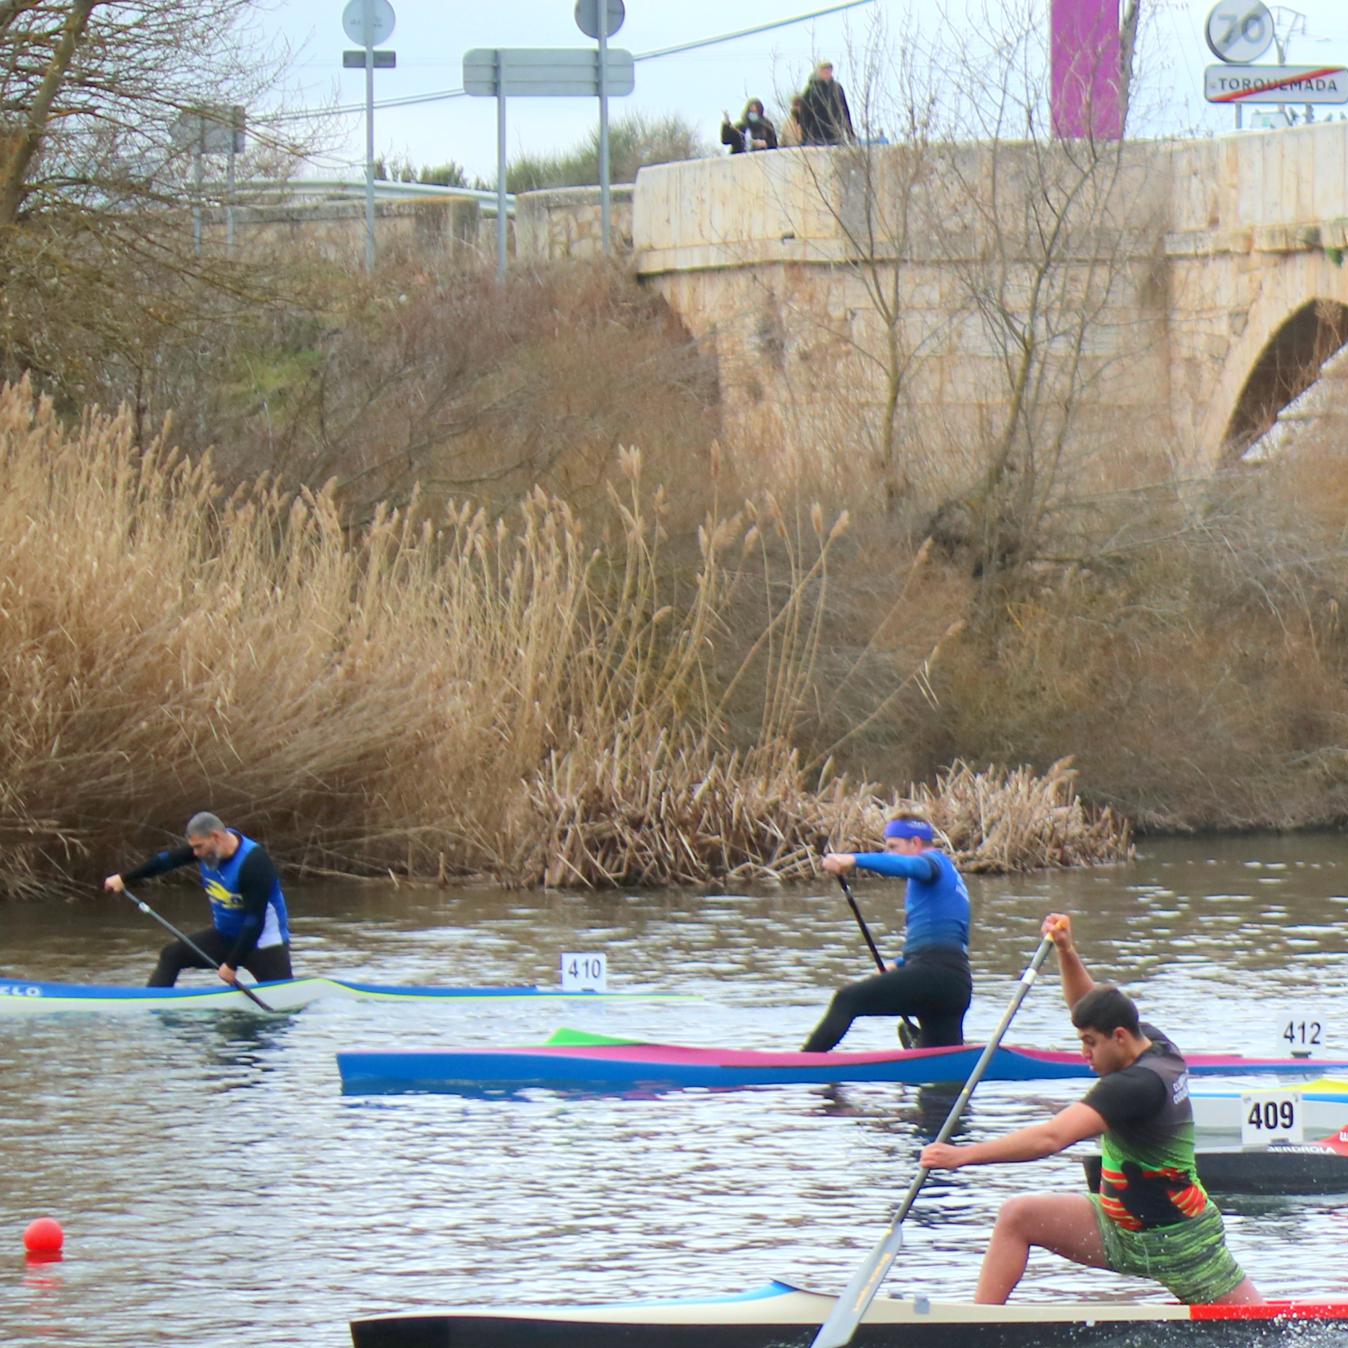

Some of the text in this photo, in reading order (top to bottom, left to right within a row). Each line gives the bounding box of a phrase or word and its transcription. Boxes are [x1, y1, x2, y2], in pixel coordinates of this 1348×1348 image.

[1217, 13, 1265, 44] 70
[1218, 77, 1338, 92] TORQUEMADA
[568, 959, 601, 978] 410
[1283, 1021, 1321, 1044] 412
[1248, 1101, 1294, 1129] 409
